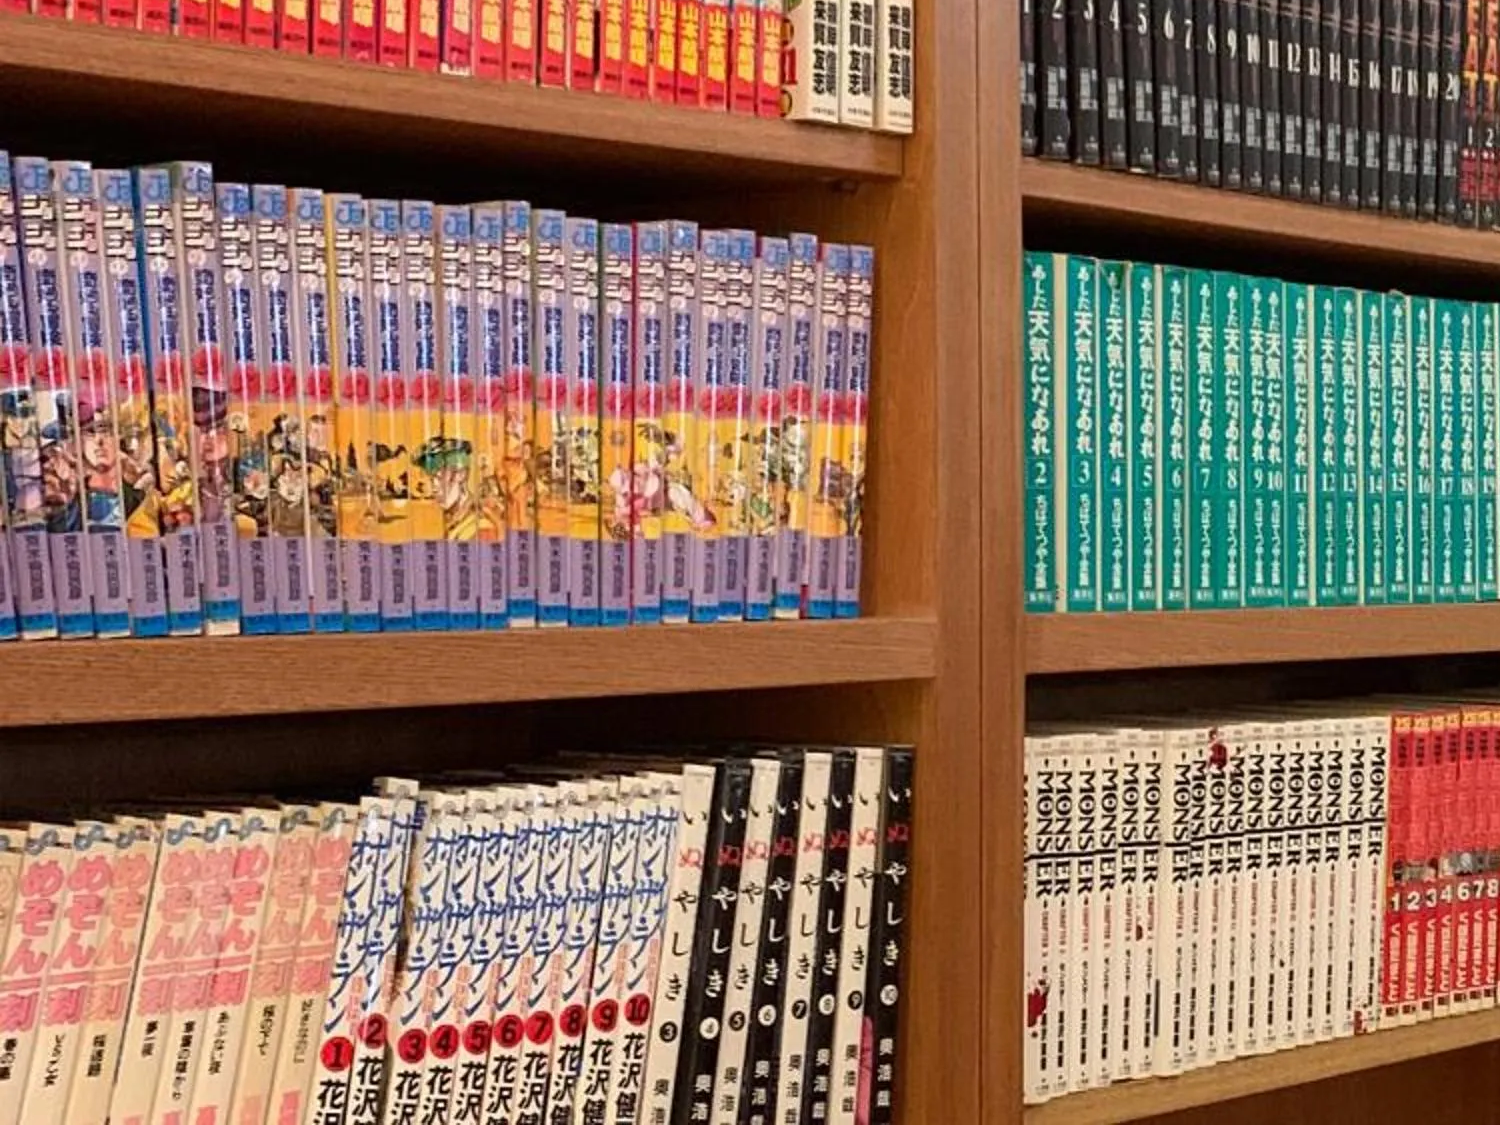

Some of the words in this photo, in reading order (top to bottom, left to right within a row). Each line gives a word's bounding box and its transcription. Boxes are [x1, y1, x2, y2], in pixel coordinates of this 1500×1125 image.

[1137, 2, 1147, 35] 5
[1163, 8, 1174, 40] 6
[1426, 888, 1438, 908] 3
[1457, 882, 1470, 901] 6
[1472, 879, 1484, 899] 7
[1407, 891, 1421, 911] 2
